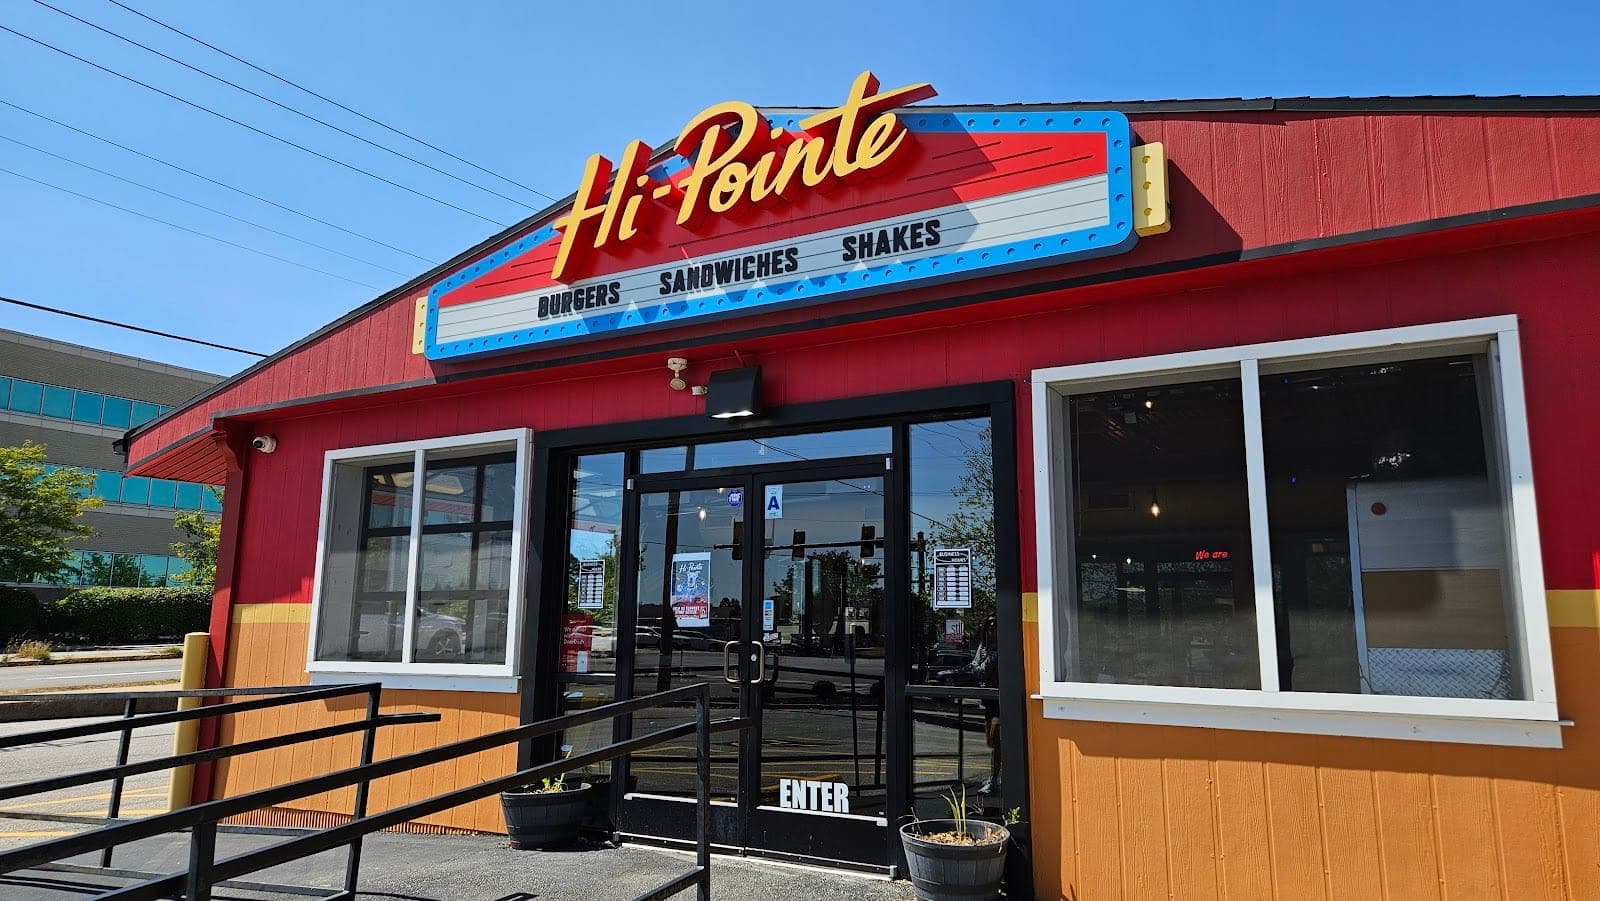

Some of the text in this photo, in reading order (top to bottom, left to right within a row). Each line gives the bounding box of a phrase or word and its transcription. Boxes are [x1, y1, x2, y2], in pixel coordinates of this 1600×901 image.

[550, 70, 935, 280] Hi-Pointe
[537, 219, 941, 319] BURGERS SANDWICHES SHAKES
[767, 495, 780, 511] A
[1195, 550, 1229, 560] We are
[780, 779, 849, 813] ENTER
